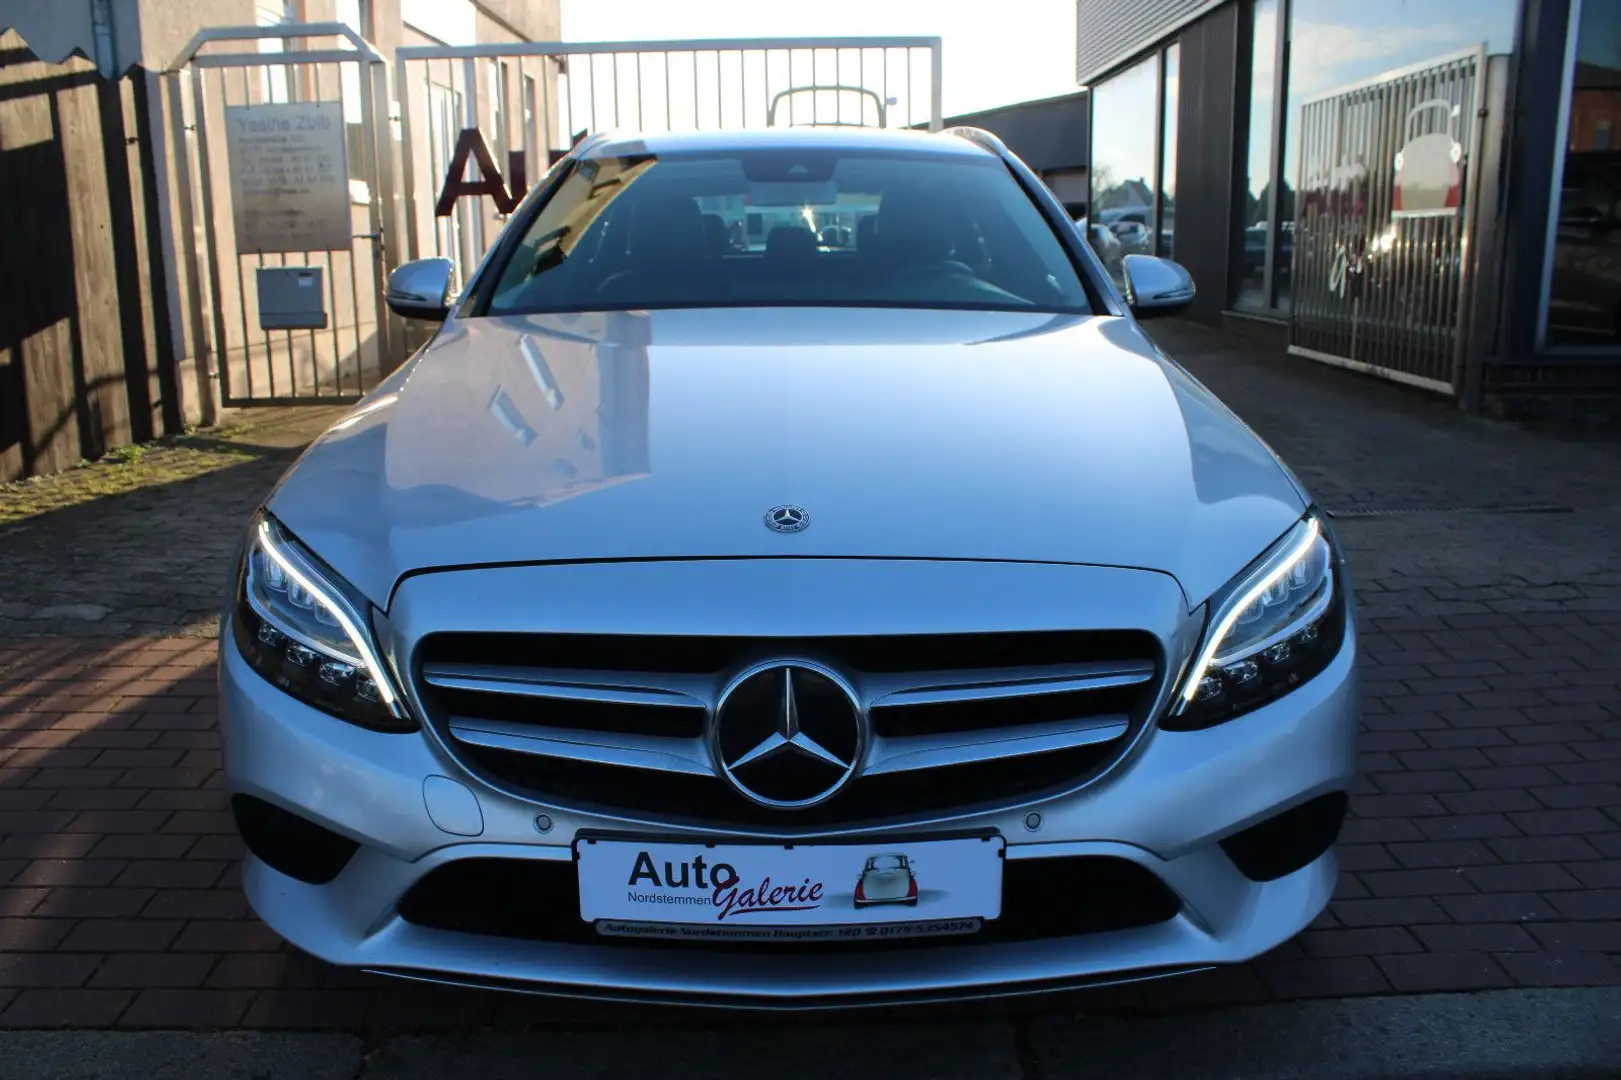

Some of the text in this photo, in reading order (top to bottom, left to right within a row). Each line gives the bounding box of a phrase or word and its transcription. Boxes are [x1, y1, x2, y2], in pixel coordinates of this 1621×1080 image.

[628, 851, 738, 889] Auto
[628, 891, 712, 906] Nordstemmen
[712, 875, 824, 921] Galerie
[604, 923, 677, 935] Autogalerie
